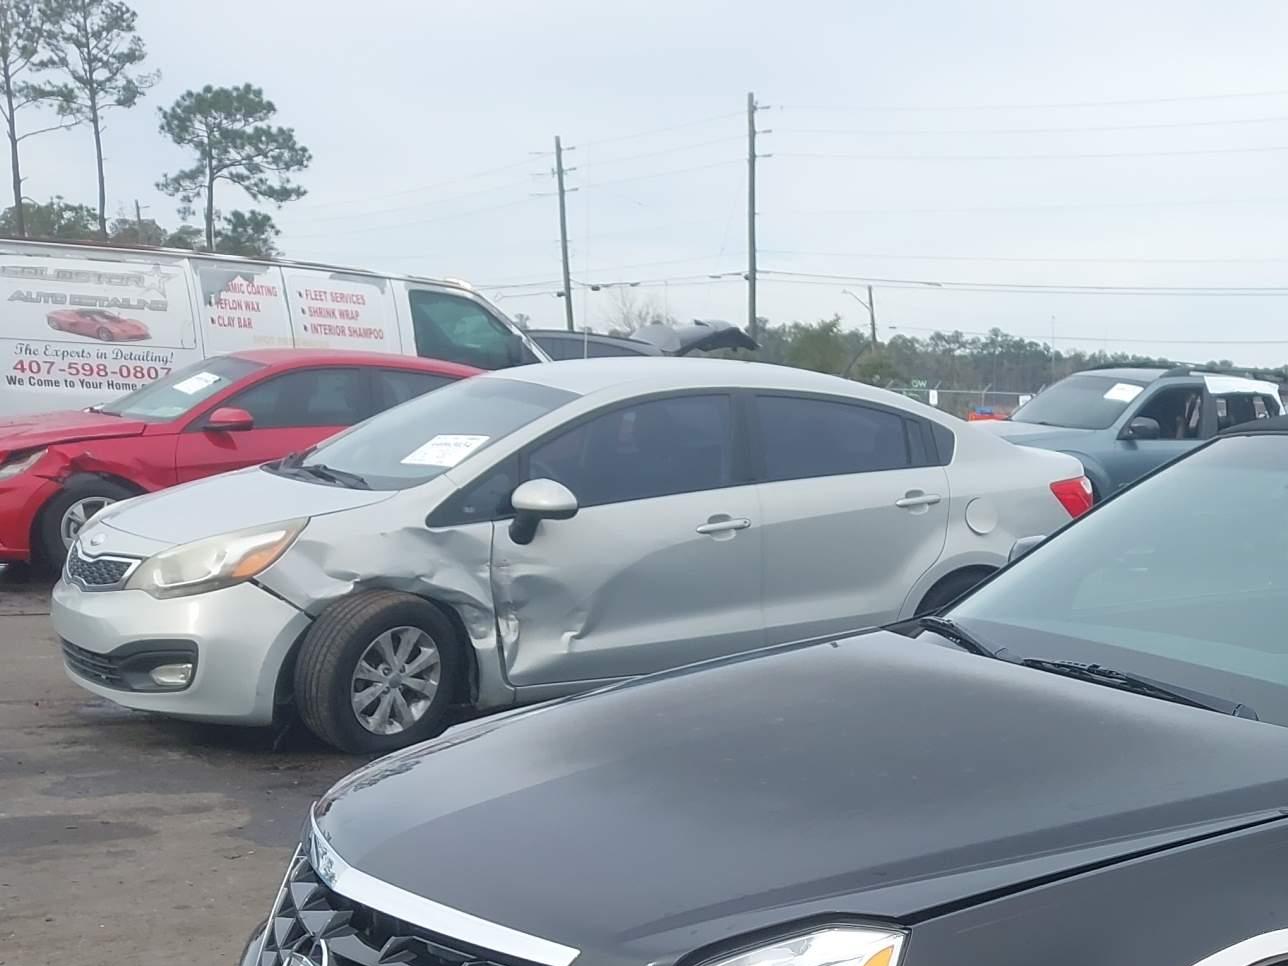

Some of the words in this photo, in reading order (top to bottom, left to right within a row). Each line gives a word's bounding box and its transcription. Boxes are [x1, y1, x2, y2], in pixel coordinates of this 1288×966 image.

[8, 290, 67, 305] AUTO
[246, 283, 278, 297] COATING
[305, 289, 327, 301] FLEET
[330, 291, 366, 305] SERVICES
[245, 301, 261, 312] WAX
[308, 306, 337, 319] SHRINK
[338, 308, 359, 320] WRAP
[217, 315, 235, 327] CLAY
[237, 316, 253, 328] BAR
[310, 323, 346, 337] INTERIOR
[347, 326, 384, 339] SHAMPOO
[14, 343, 39, 356] The
[43, 344, 91, 360] Experts
[96, 349, 107, 360] in
[112, 350, 174, 364] Detailing!
[13, 359, 172, 380] 407-598-0807
[6, 375, 24, 386] We
[28, 375, 60, 388] Come
[64, 378, 75, 389] to
[78, 378, 103, 390] Your
[107, 381, 137, 391] Home
